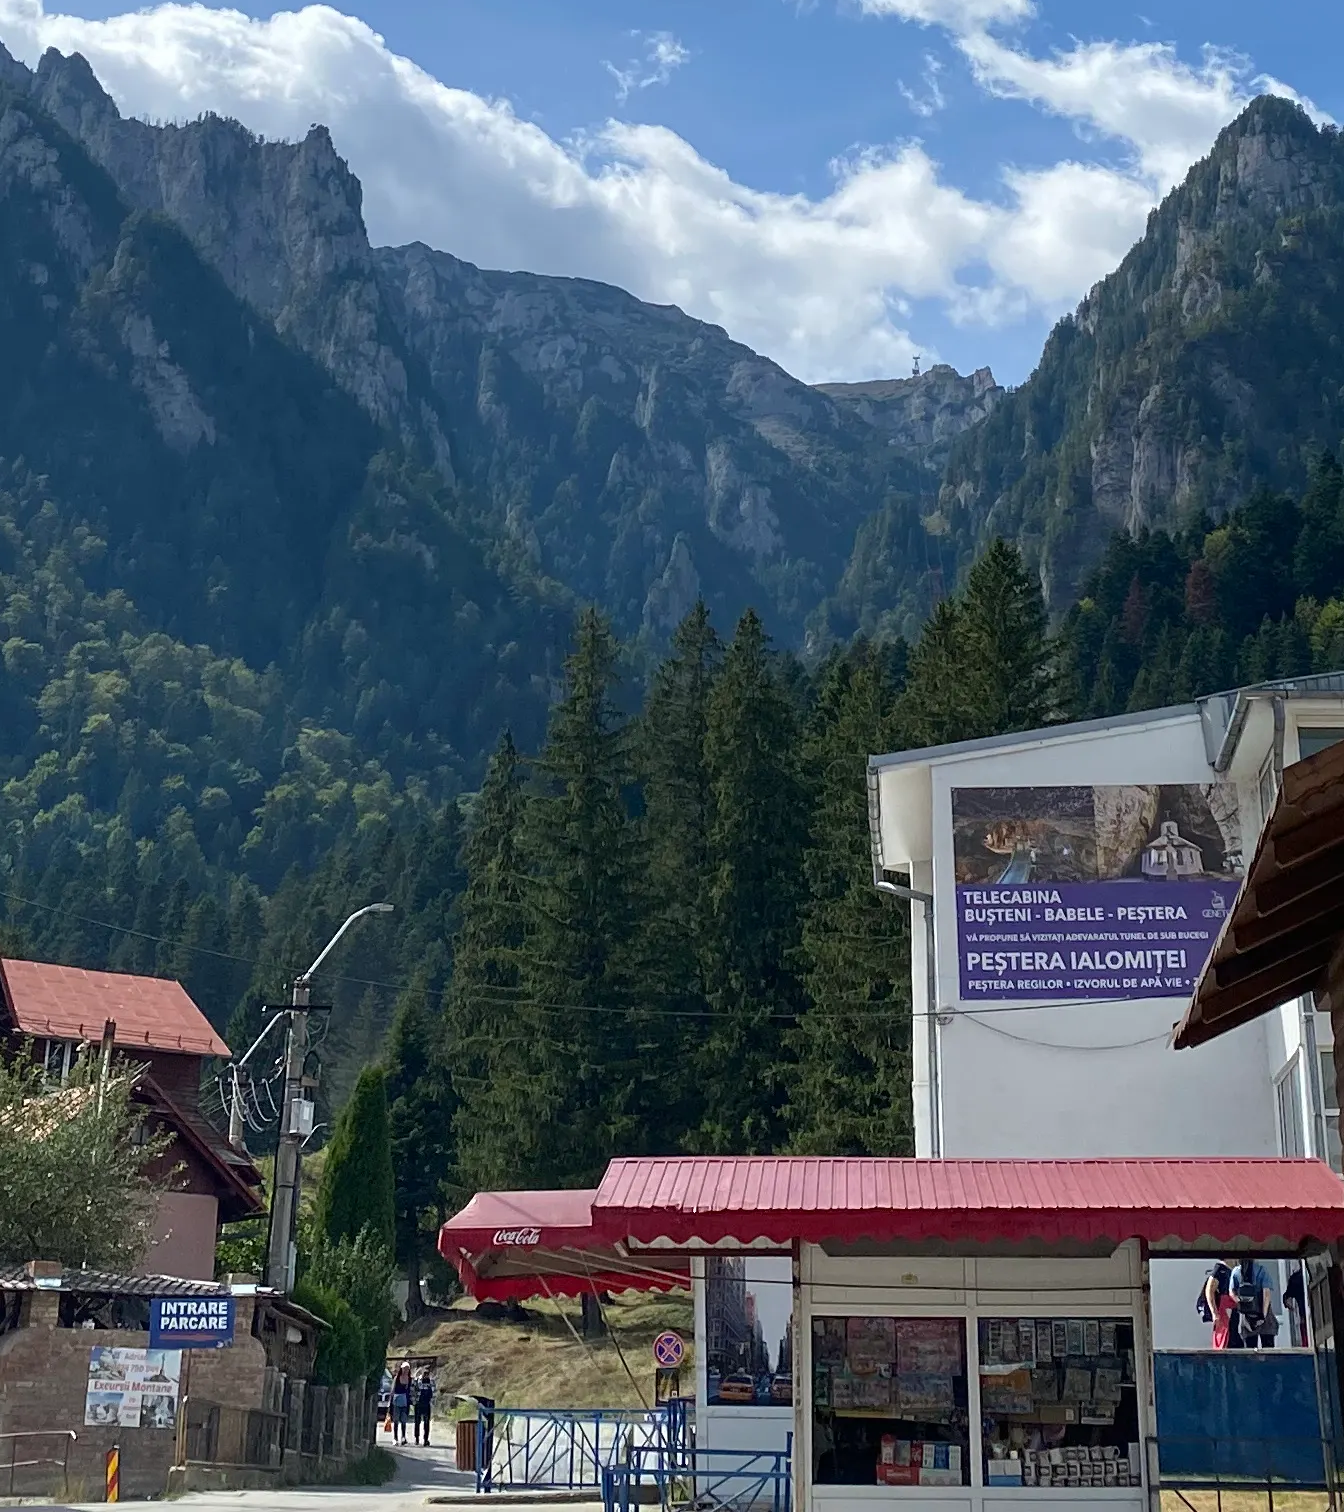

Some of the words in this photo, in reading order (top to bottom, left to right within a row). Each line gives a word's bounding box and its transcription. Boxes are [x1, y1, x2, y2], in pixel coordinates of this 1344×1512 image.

[962, 890, 1062, 904] TELECABINA
[964, 908, 1032, 926] BUȘTENI
[1044, 907, 1105, 922] BABELE
[1117, 906, 1188, 924] PEȘTERA
[979, 934, 1018, 942] PROPUNE
[1120, 932, 1147, 941] TUNEL
[1147, 932, 1159, 940] DE
[1160, 931, 1177, 940] SUB
[1178, 931, 1209, 940] BUCEGI
[967, 951, 1067, 976] PEȘTERA
[1069, 949, 1188, 974] IALOMIȚEI
[968, 979, 1016, 993] PEȘTERA
[1016, 978, 1064, 990] REGILOR
[1073, 978, 1121, 989] IZVORUL
[1122, 978, 1138, 988] DE
[1140, 975, 1163, 988] APĂ
[1164, 977, 1183, 987] VIE
[160, 1301, 229, 1315] INTRARE
[159, 1316, 229, 1330] PARCARE
[94, 1380, 130, 1392] Excursii
[131, 1381, 173, 1394] Montane
